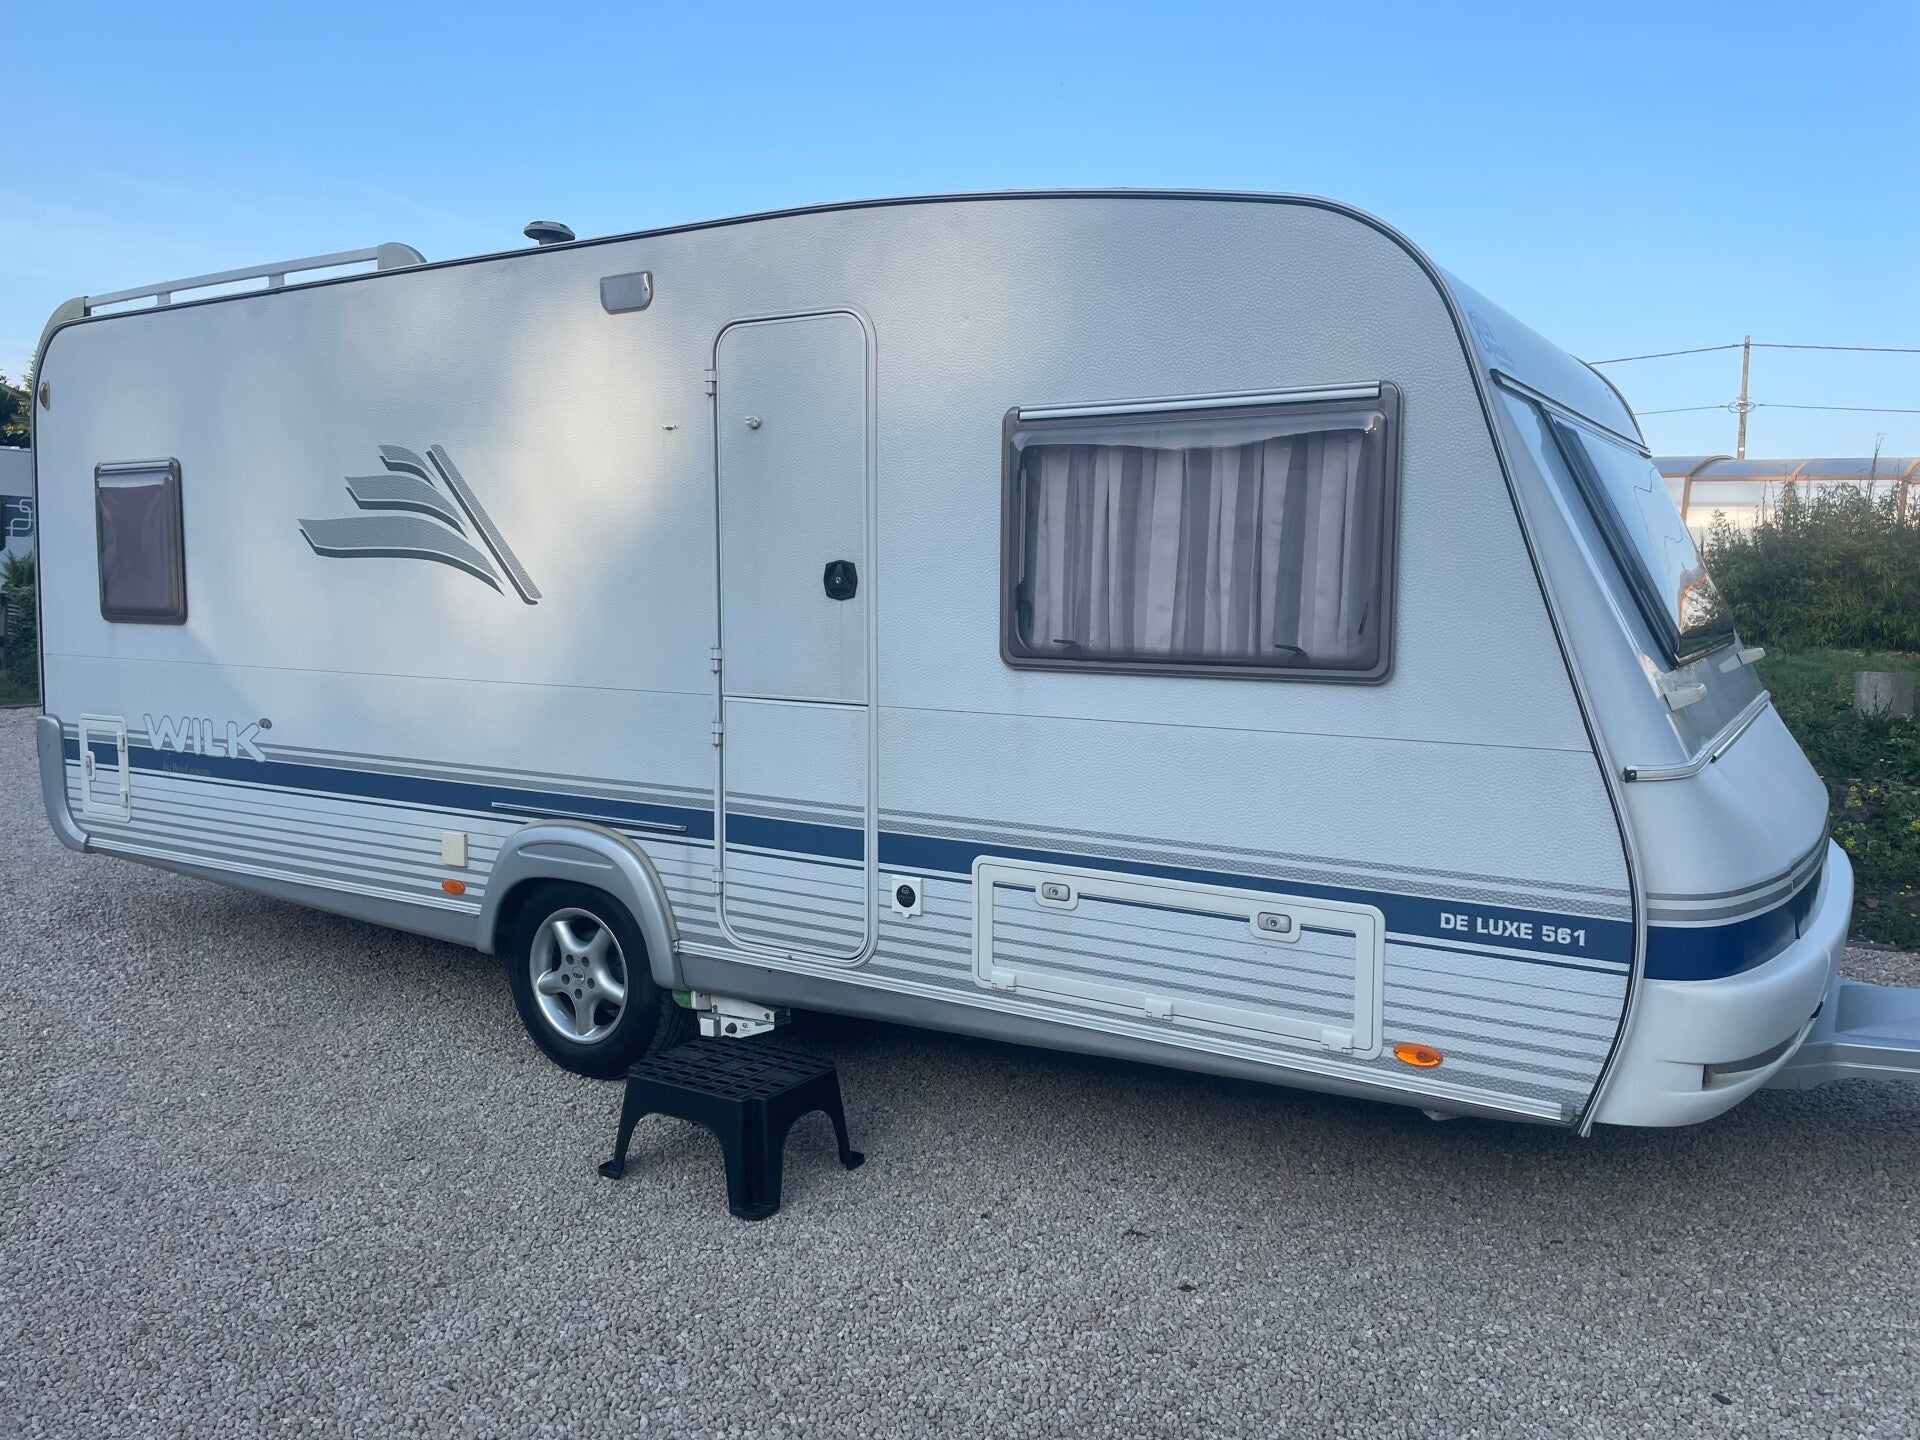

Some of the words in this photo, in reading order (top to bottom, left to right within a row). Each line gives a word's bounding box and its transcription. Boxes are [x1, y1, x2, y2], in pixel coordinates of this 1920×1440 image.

[143, 713, 266, 763] WILK
[1440, 912, 1469, 931] DE
[1476, 916, 1533, 940] LUXE
[1541, 925, 1586, 947] 561
